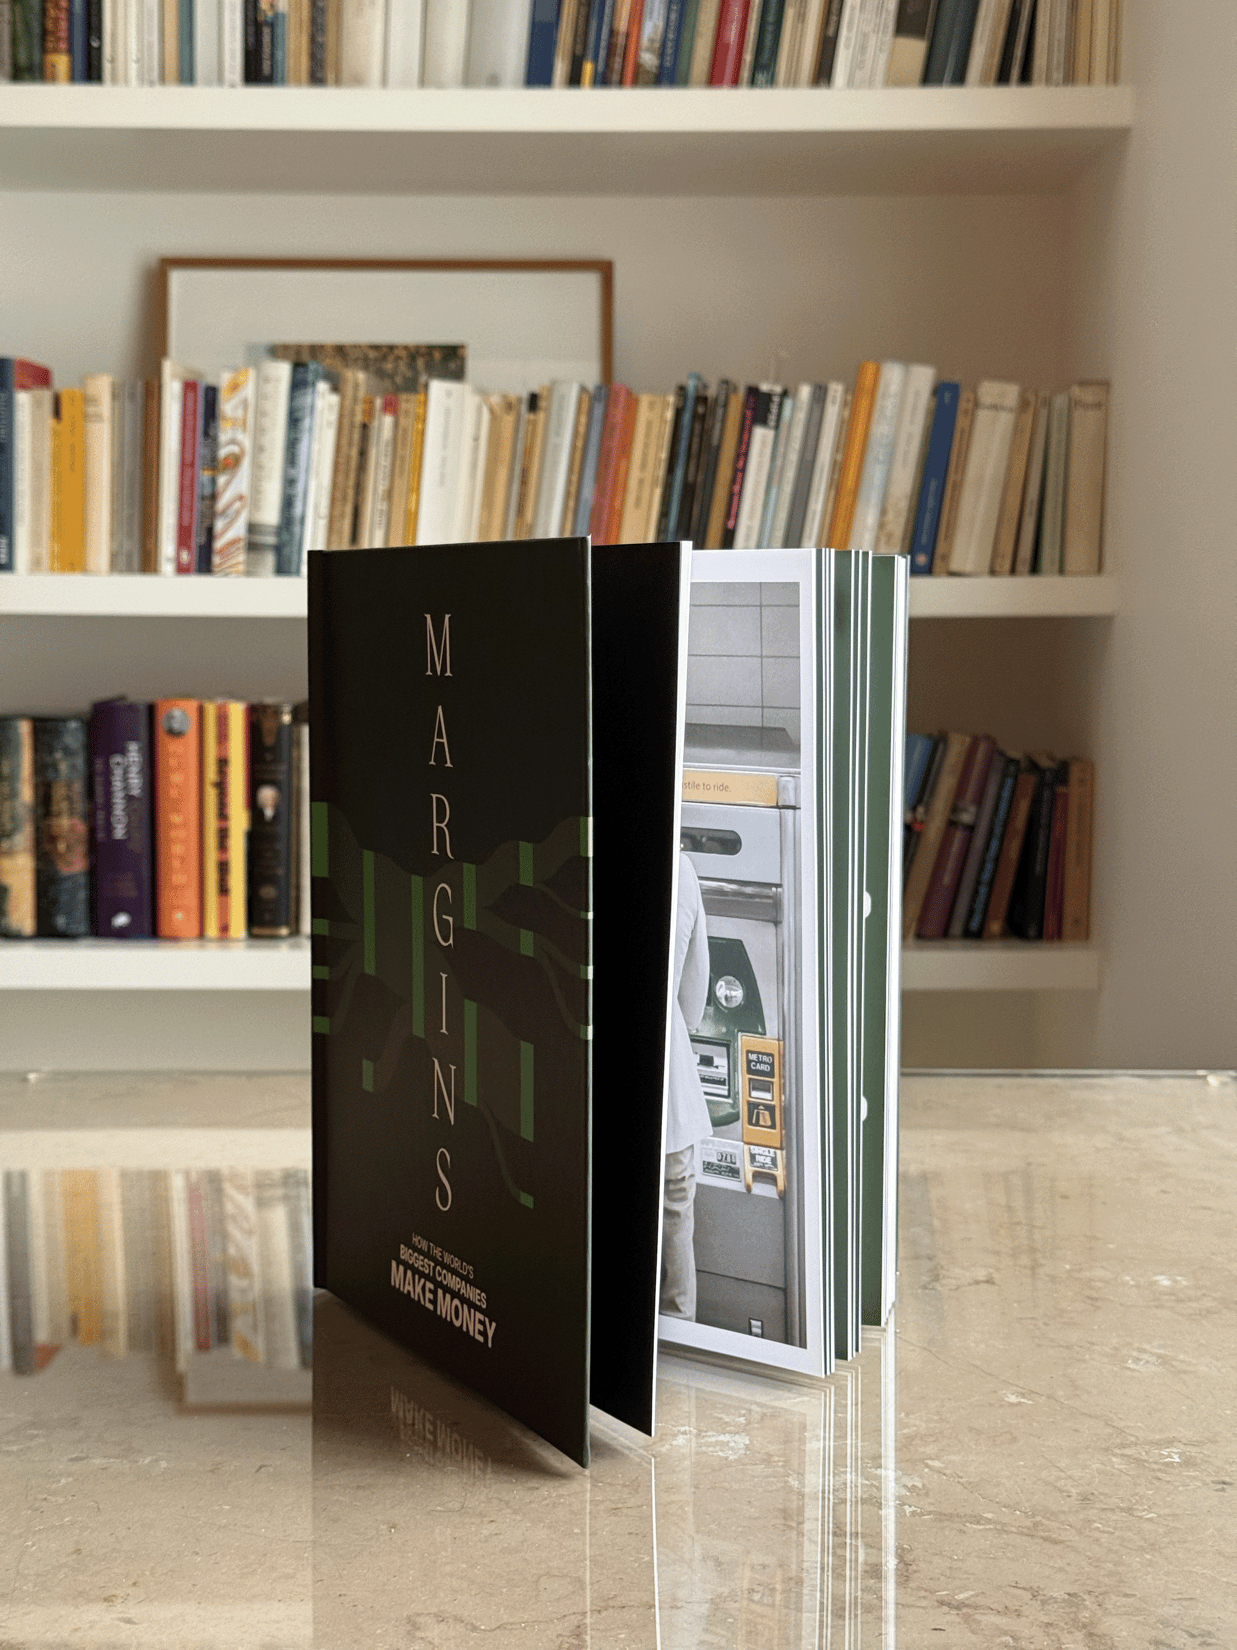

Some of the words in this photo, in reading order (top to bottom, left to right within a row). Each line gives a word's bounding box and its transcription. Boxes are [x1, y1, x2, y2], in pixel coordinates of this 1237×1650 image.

[703, 782, 711, 791] to
[713, 782, 731, 793] ride.
[424, 613, 457, 1212] MARGINS
[748, 1053, 773, 1063] METRO
[750, 1062, 771, 1072] CARD
[400, 1243, 434, 1277] BIGGEST
[435, 1266, 487, 1309] COMPANIES
[412, 1232, 428, 1253] HOW
[429, 1241, 443, 1261] THE
[443, 1250, 474, 1279] WORLD'S
[391, 1259, 434, 1312] MAKE
[437, 1287, 497, 1348] MONEY
